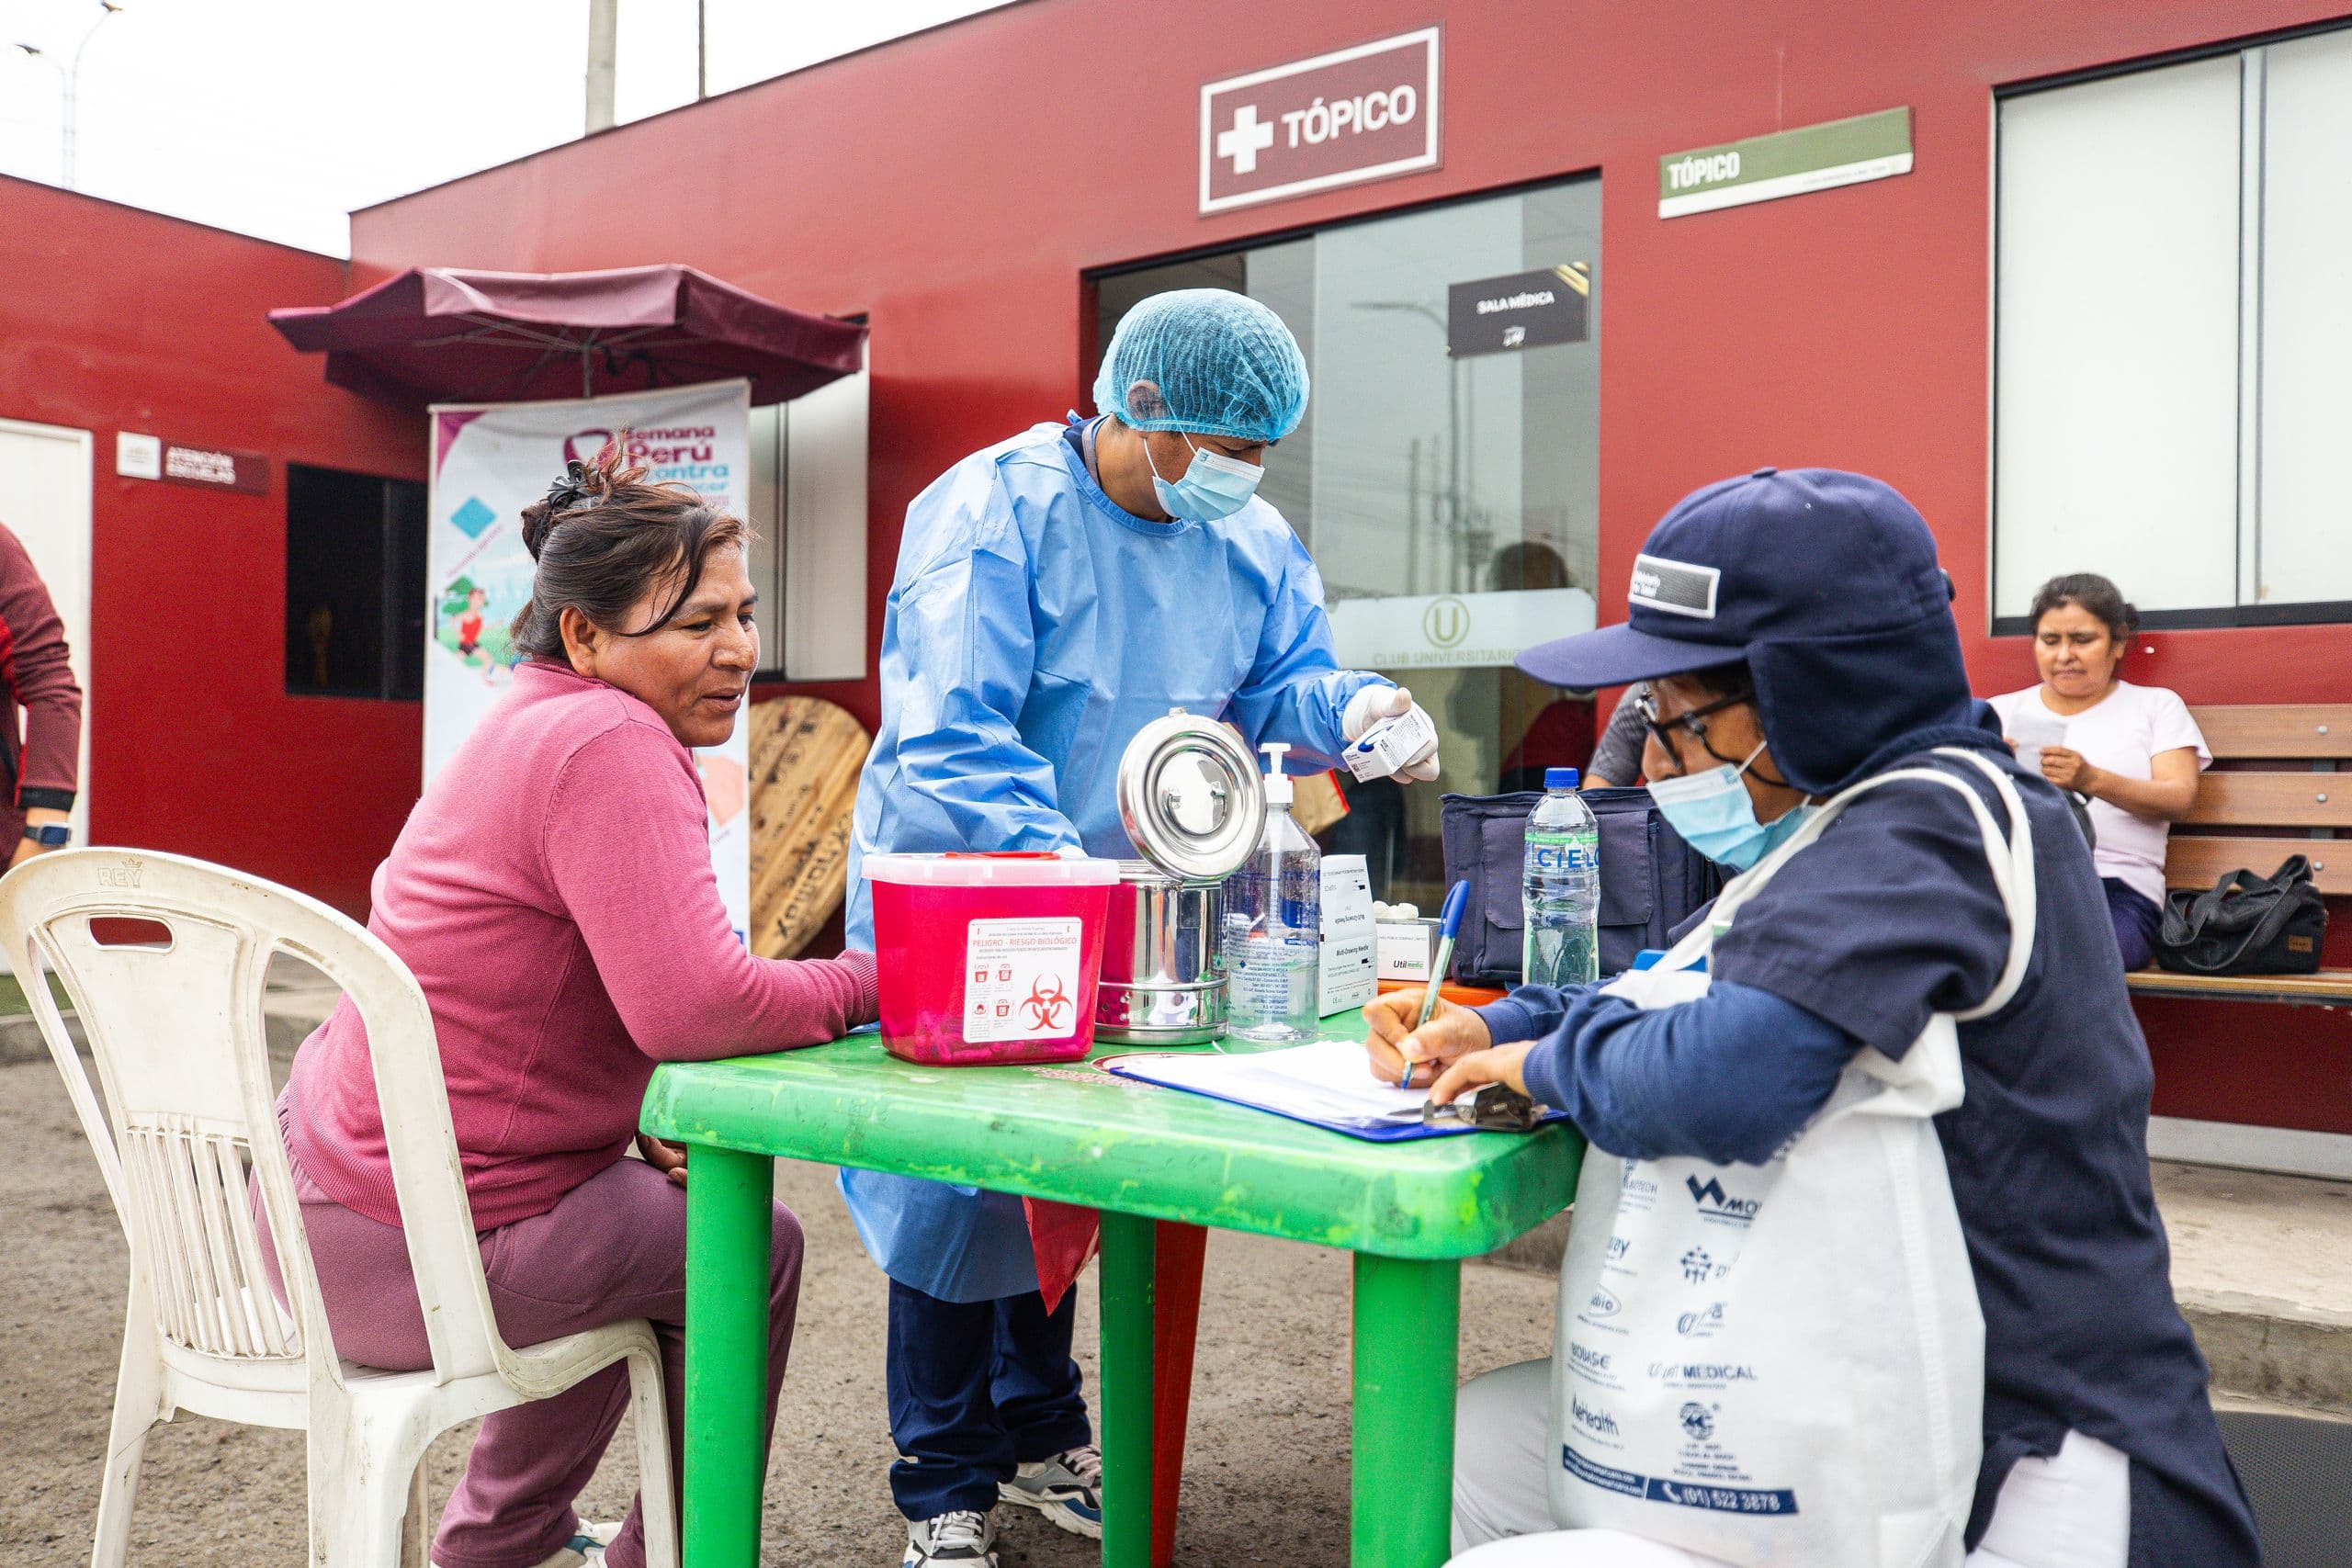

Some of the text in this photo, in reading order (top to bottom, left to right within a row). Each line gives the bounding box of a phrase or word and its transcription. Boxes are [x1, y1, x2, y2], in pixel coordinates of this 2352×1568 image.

[1281, 84, 1417, 149] TÓPICO
[1668, 152, 1741, 189] TÓPICO
[1476, 290, 1555, 315] SALA MÉDICA
[628, 438, 713, 468] Perú
[650, 463, 729, 479] ontra
[1434, 606, 1459, 642] U
[1374, 651, 1408, 665] CLUB
[97, 867, 143, 889] REY
[973, 939, 1003, 948] PELIGRO
[1010, 937, 1036, 946] RIESGO
[1037, 936, 1078, 945] BIOLÓGICO
[1683, 1364, 1757, 1382] MEDICAL
[1682, 1485, 1711, 1507] (01)
[1711, 1489, 1738, 1510] 522
